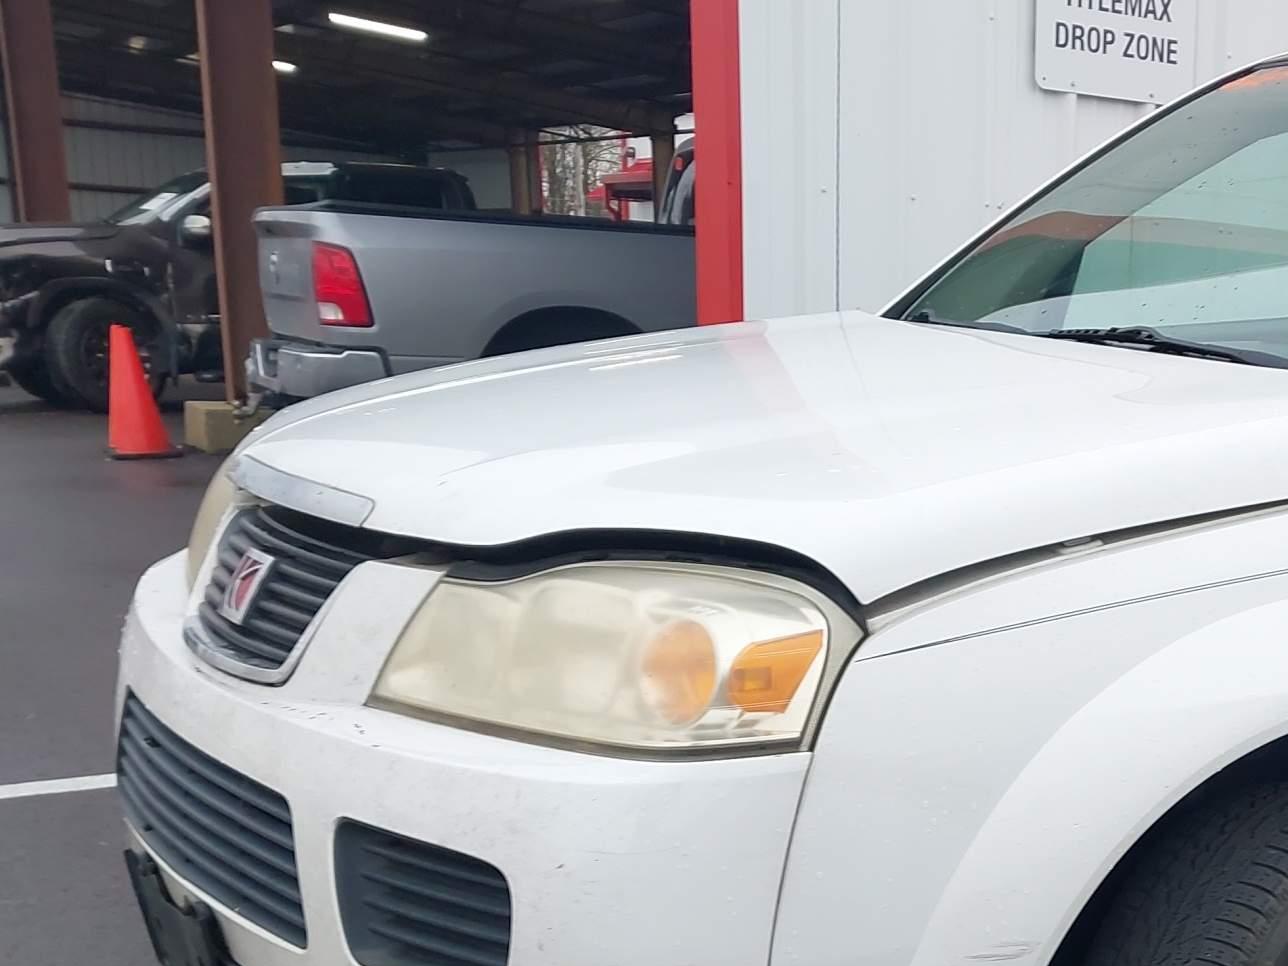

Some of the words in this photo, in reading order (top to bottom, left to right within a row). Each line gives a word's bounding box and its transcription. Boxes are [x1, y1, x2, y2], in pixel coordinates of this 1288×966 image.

[1067, 0, 1173, 23] LEMAX
[1055, 22, 1116, 55] DROP
[1122, 32, 1178, 65] ZONE
